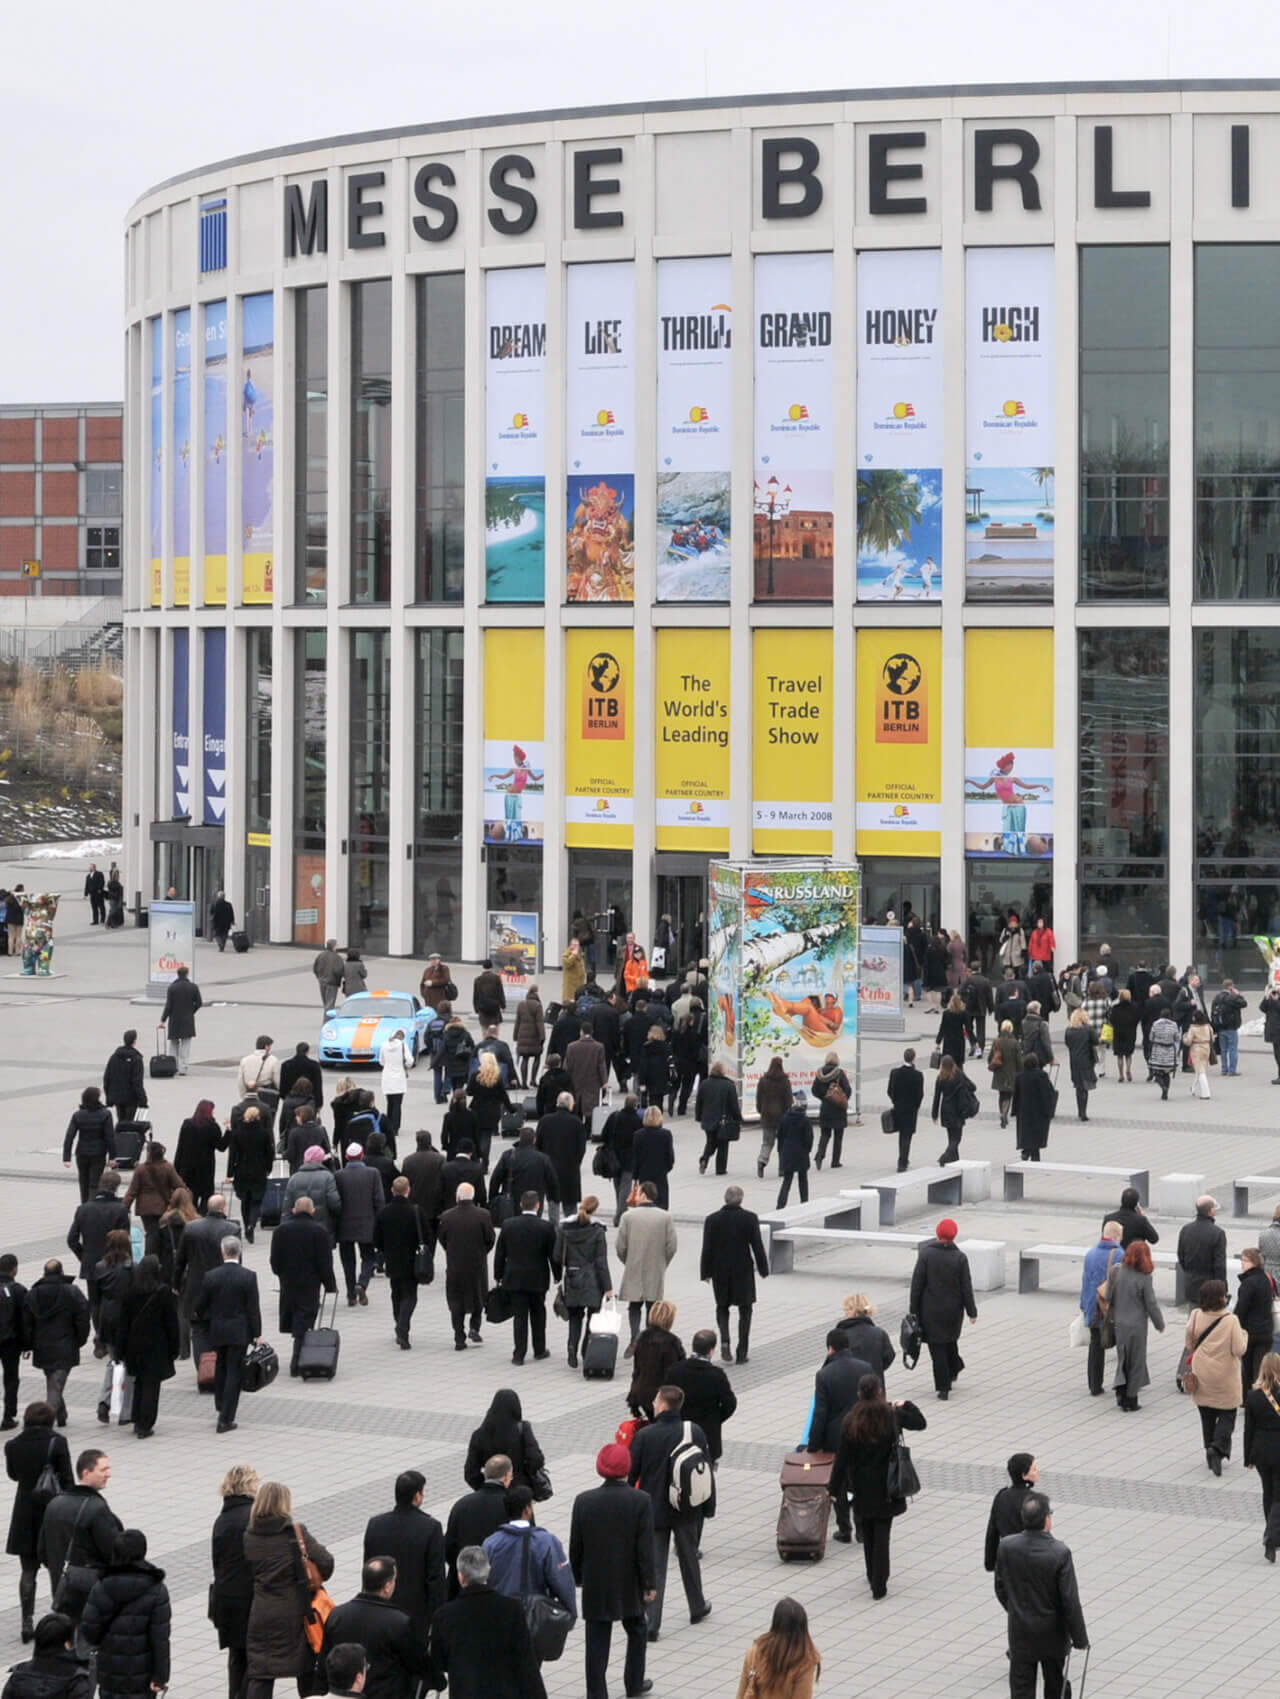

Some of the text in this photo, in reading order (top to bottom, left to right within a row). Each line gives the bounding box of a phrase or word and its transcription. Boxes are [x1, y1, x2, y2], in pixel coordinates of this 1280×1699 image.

[284, 148, 624, 258] MESSE
[661, 314, 732, 351] THRILL
[760, 311, 832, 348] GRAND
[866, 308, 938, 344] HONEY
[982, 306, 1040, 342] HIGH
[490, 323, 546, 360] DREAM
[584, 320, 622, 354] LIFE
[681, 675, 711, 692] The
[768, 675, 822, 693] Travel
[588, 698, 619, 717] ITB
[664, 700, 728, 718] World's
[769, 702, 820, 719] Trade
[883, 700, 920, 720] ITB
[588, 719, 618, 729] BERLIN
[883, 722, 919, 732] BERLIN
[663, 726, 728, 747] Leading
[768, 727, 819, 744] Show
[867, 792, 934, 801] PARTNER COUNTRY
[757, 811, 762, 820] 5
[770, 811, 775, 820] 9
[779, 811, 807, 821] March
[810, 811, 832, 821] 2008
[775, 885, 854, 900] RUSSLAND
[860, 985, 892, 1001] Cuba
